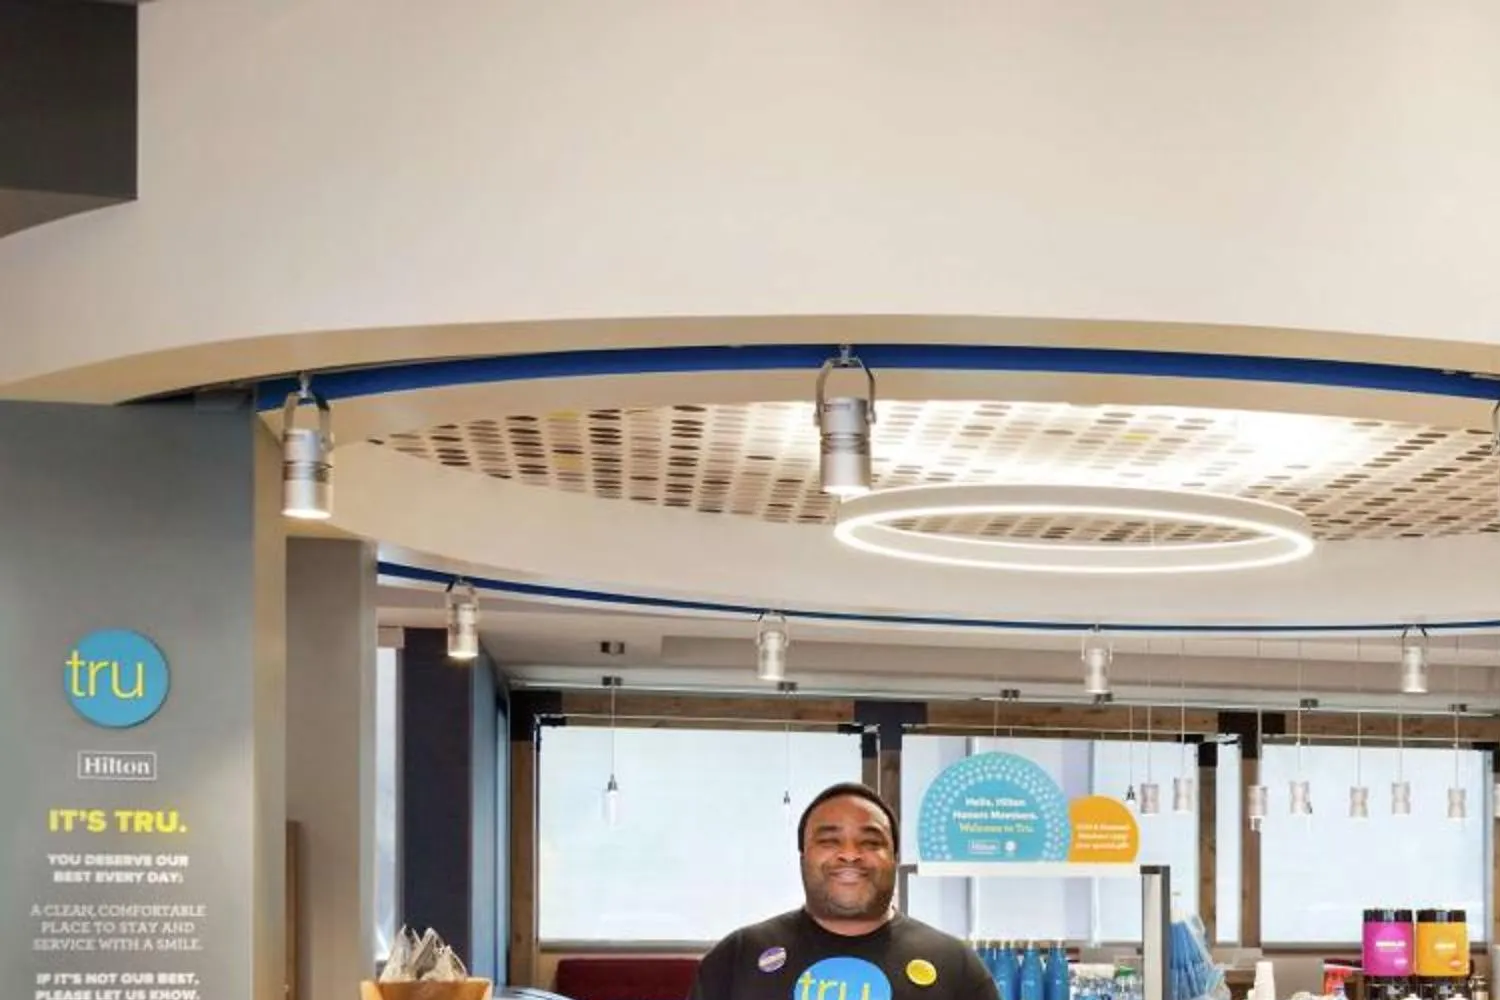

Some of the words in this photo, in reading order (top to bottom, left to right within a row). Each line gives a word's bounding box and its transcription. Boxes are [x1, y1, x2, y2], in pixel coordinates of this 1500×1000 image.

[65, 650, 144, 698] tru
[84, 756, 151, 775] Hilton
[49, 808, 107, 832] IT'S
[113, 809, 188, 833] TRU.
[48, 854, 81, 867] YOU
[84, 854, 153, 867] DESERVE
[155, 854, 189, 867] OUR
[53, 871, 91, 883] BEST
[95, 871, 145, 883] EVERY
[41, 921, 91, 934] PLACE
[94, 921, 116, 934] TO
[119, 921, 159, 934] STAY
[161, 921, 195, 934] AND
[33, 937, 95, 951] SERVICE
[36, 973, 51, 985] IF
[85, 973, 118, 985] NOT
[120, 973, 154, 985] OUR
[95, 989, 122, 1000] LET
[125, 989, 146, 1000] US
